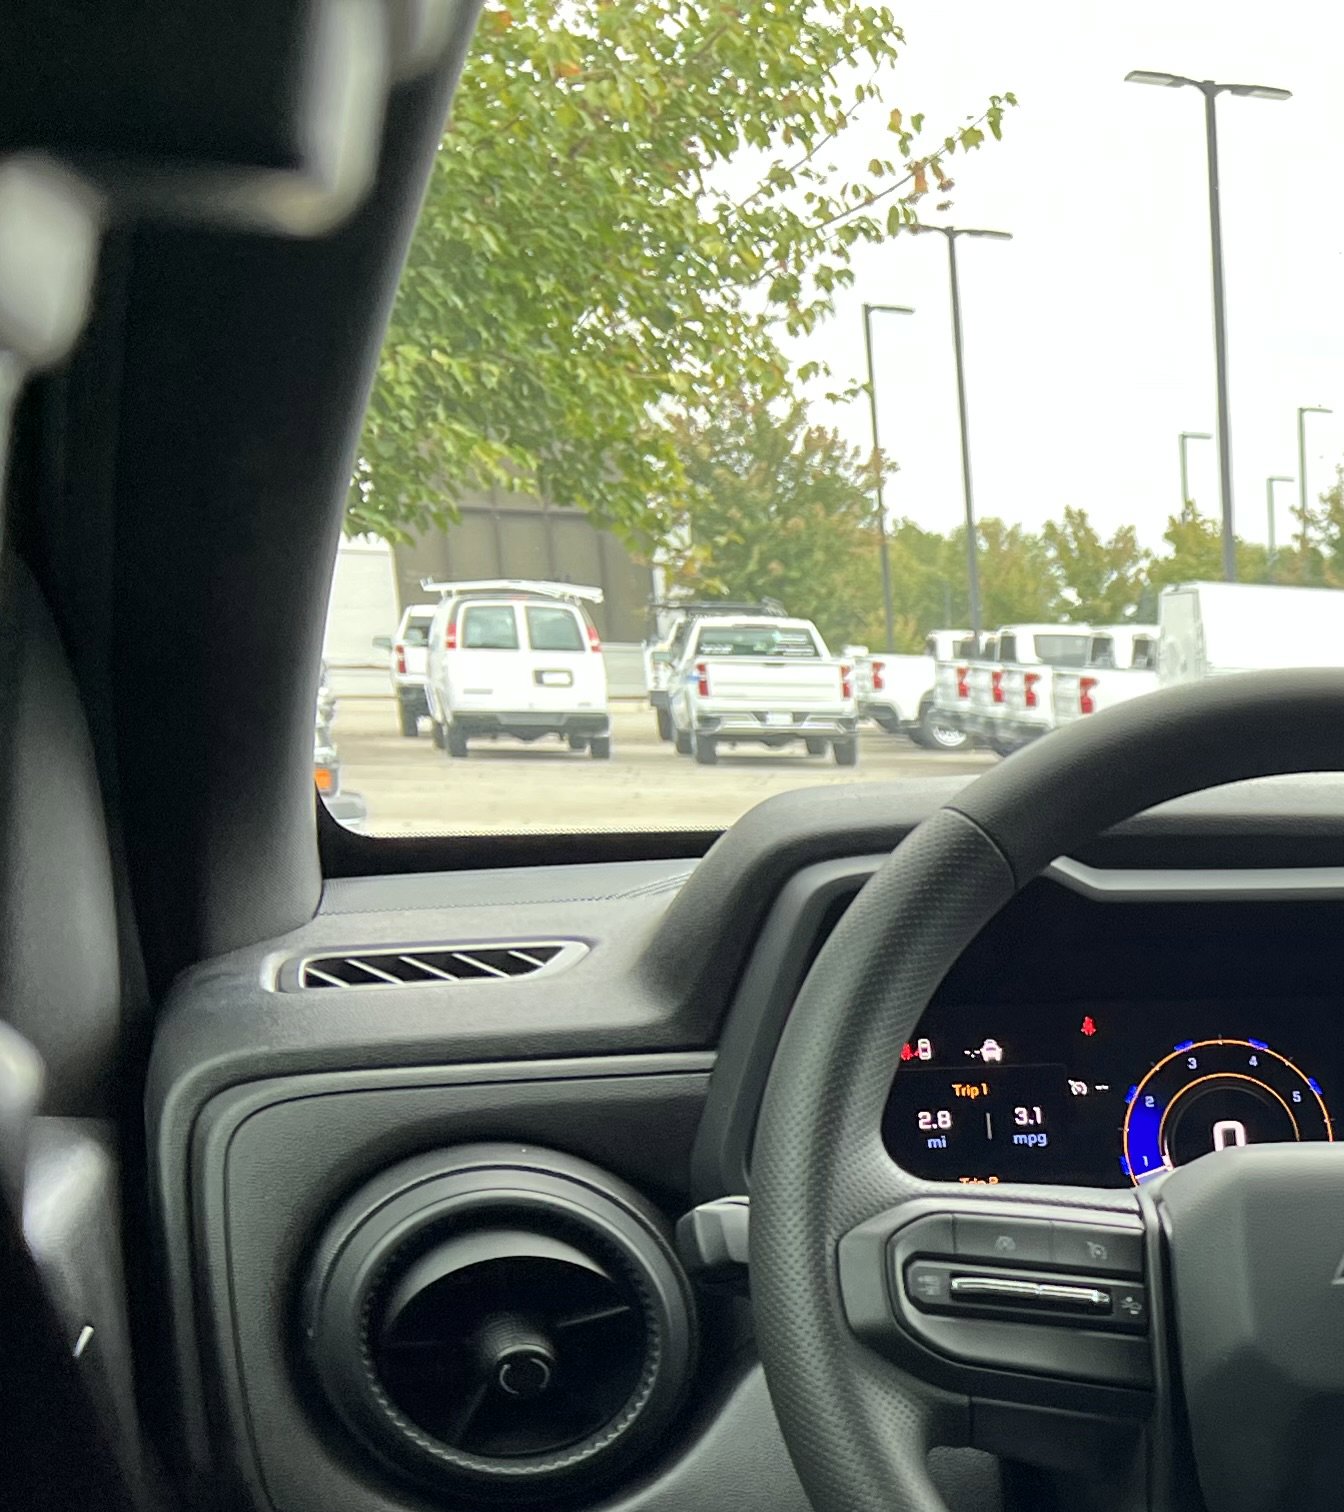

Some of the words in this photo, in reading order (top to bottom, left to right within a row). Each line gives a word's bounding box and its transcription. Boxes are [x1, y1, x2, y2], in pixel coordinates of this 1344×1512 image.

[1187, 1057, 1197, 1069] 3
[1249, 1055, 1258, 1067] 4
[951, 1083, 980, 1100] Trip
[980, 1082, 988, 1096] 1
[1292, 1091, 1302, 1103] 5
[1144, 1096, 1155, 1108] 2
[917, 1110, 952, 1130] 2.8
[1014, 1106, 1042, 1125] 3.1
[927, 1135, 947, 1149] mi
[1012, 1133, 1047, 1148] mpg
[1142, 1155, 1149, 1168] 1
